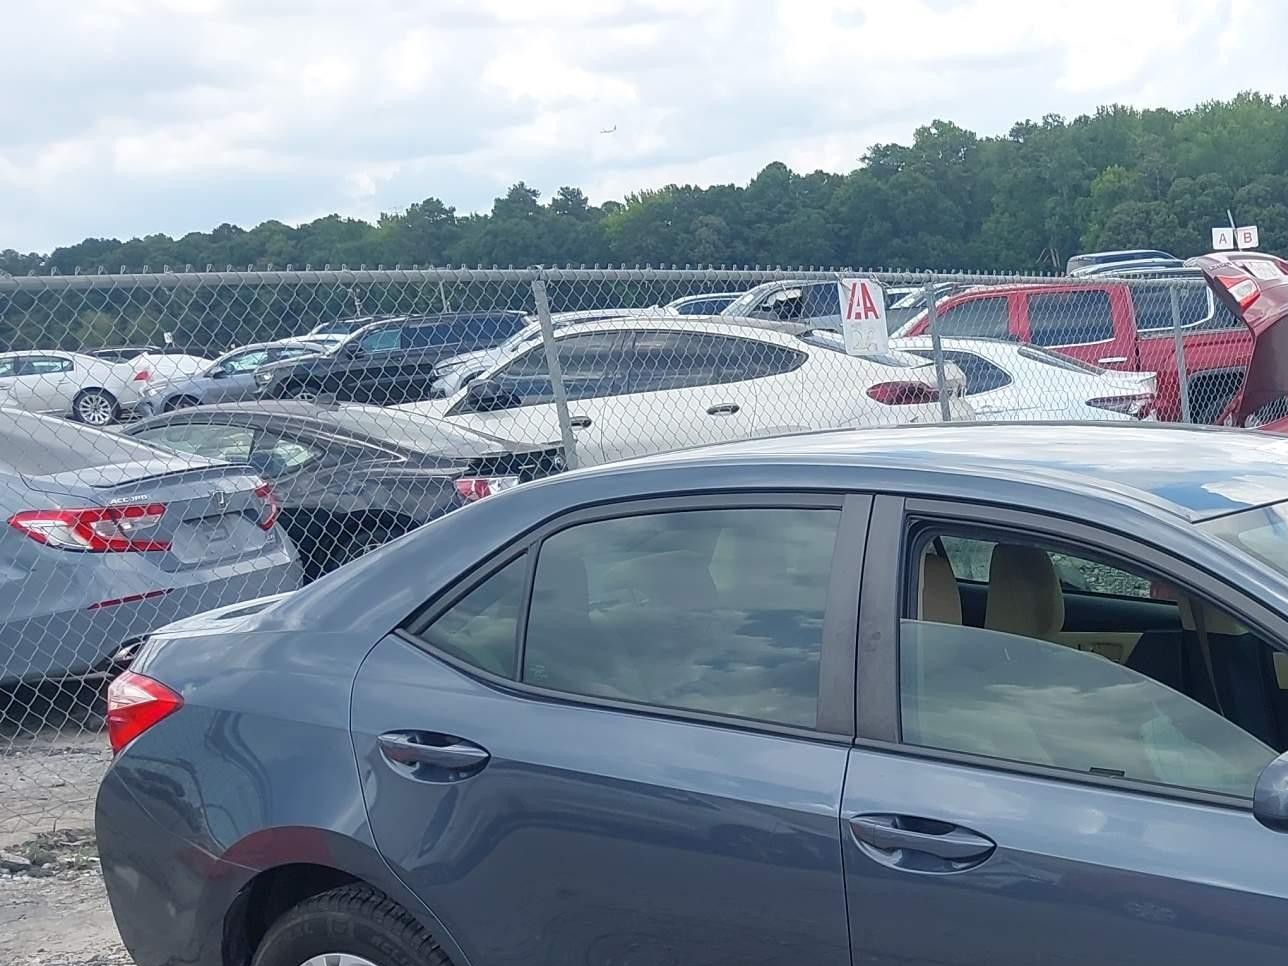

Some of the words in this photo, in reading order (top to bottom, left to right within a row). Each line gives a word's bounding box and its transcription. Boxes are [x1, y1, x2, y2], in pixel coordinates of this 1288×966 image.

[1219, 232, 1228, 245] A
[1243, 231, 1253, 244] B
[110, 494, 148, 504] ACCORD
